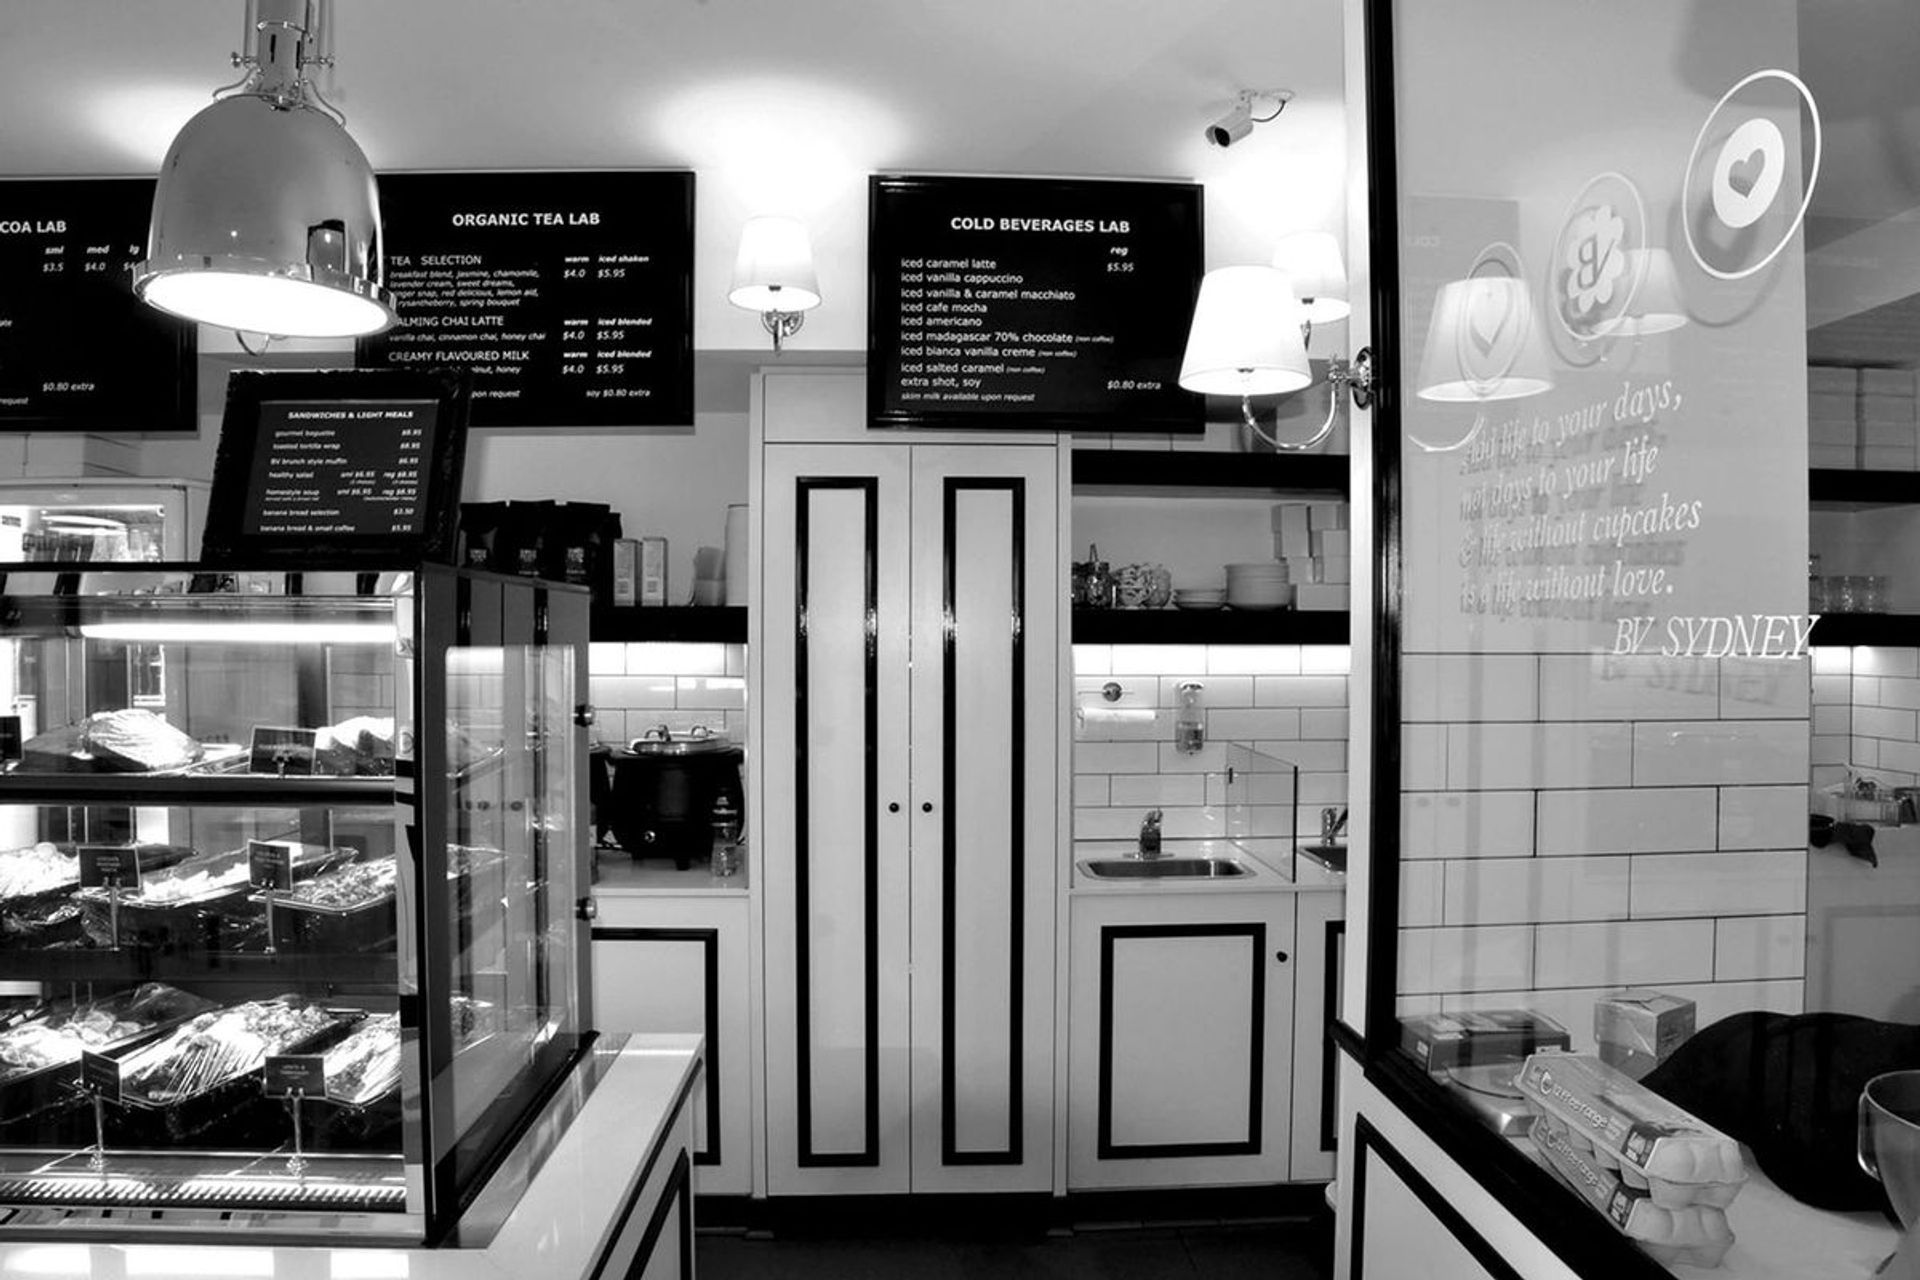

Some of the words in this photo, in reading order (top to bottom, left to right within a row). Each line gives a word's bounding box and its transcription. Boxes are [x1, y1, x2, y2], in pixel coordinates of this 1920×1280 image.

[452, 213, 529, 226] ORGANIC
[533, 213, 564, 225] TEA
[569, 213, 600, 225] LAB
[0, 221, 32, 234] COA
[37, 221, 67, 233] LAB
[951, 217, 995, 230] COLD
[1000, 219, 1095, 232] BEVERAGES
[1099, 220, 1130, 233] LAB
[45, 246, 64, 254] sml
[87, 245, 109, 254] med
[1110, 246, 1128, 256] reg
[391, 256, 410, 265] TEA
[421, 255, 482, 265] SELECTION
[598, 255, 617, 263] iced
[618, 255, 649, 263] shaken
[901, 259, 923, 268] iced
[926, 259, 969, 269] caramel
[972, 259, 996, 269] latte
[43, 262, 64, 272] $3.5
[85, 262, 105, 272] $4.0
[1107, 262, 1134, 272] $5.95
[563, 268, 586, 278] $4.0
[598, 268, 625, 278] $5.95
[901, 273, 923, 283] iced
[926, 273, 961, 283] vanilla
[964, 274, 1023, 286] cappuccino
[901, 288, 923, 298] iced
[926, 288, 961, 298] vanilla
[964, 289, 973, 298] &
[975, 289, 1018, 299] caramel
[1021, 289, 1075, 300] macchiato
[901, 302, 923, 312] iced
[926, 302, 949, 312] cafe
[952, 303, 987, 313] mocha
[442, 317, 469, 326] CHAI
[472, 316, 504, 326] LATTE
[597, 318, 616, 326] iced
[617, 318, 652, 326] blended
[901, 316, 923, 326] iced
[926, 317, 983, 326] americano
[501, 332, 527, 341] honey
[563, 330, 585, 340] $4.0
[597, 330, 624, 340] $5.95
[901, 331, 923, 341] iced
[926, 332, 992, 344] madagascar
[994, 332, 1019, 342] 70%
[1022, 333, 1073, 343] chocolate
[389, 351, 433, 361] CREAMY
[436, 351, 499, 361] FLAVOURED
[503, 350, 529, 360] MILK
[597, 350, 616, 358] iced
[617, 350, 652, 358] blended
[901, 347, 923, 356] iced
[926, 347, 961, 356] bianca
[964, 347, 999, 357] vanilla
[1002, 348, 1036, 357] creme
[495, 365, 521, 375] honey
[563, 364, 584, 374] $4.0
[596, 364, 624, 374] $5.95
[901, 363, 923, 373] iced
[926, 363, 958, 373] salted
[961, 364, 1004, 373] caramel
[43, 382, 69, 392] $0.80
[70, 382, 95, 391] extra
[901, 377, 929, 387] extra
[932, 377, 959, 388] shot,
[963, 378, 980, 389] soy
[1107, 380, 1135, 390] $0.80
[1136, 381, 1162, 390] extra
[586, 389, 601, 398] soy
[603, 388, 627, 397] $0.80
[629, 388, 651, 397] extra
[901, 393, 920, 401] skim
[922, 393, 941, 401] milk
[943, 393, 979, 401] available
[981, 394, 1002, 403] upon
[1004, 393, 1035, 403] request
[1556, 402, 1607, 447] your
[1614, 381, 1683, 425] days,
[307, 458, 323, 466] style
[1539, 463, 1557, 495] to
[1563, 456, 1615, 500] your
[1622, 436, 1659, 484] life
[1593, 493, 1703, 546] cupcakes
[1612, 561, 1674, 598] love.
[1613, 617, 1654, 656] BV
[1661, 614, 1821, 660] SYDNEY
